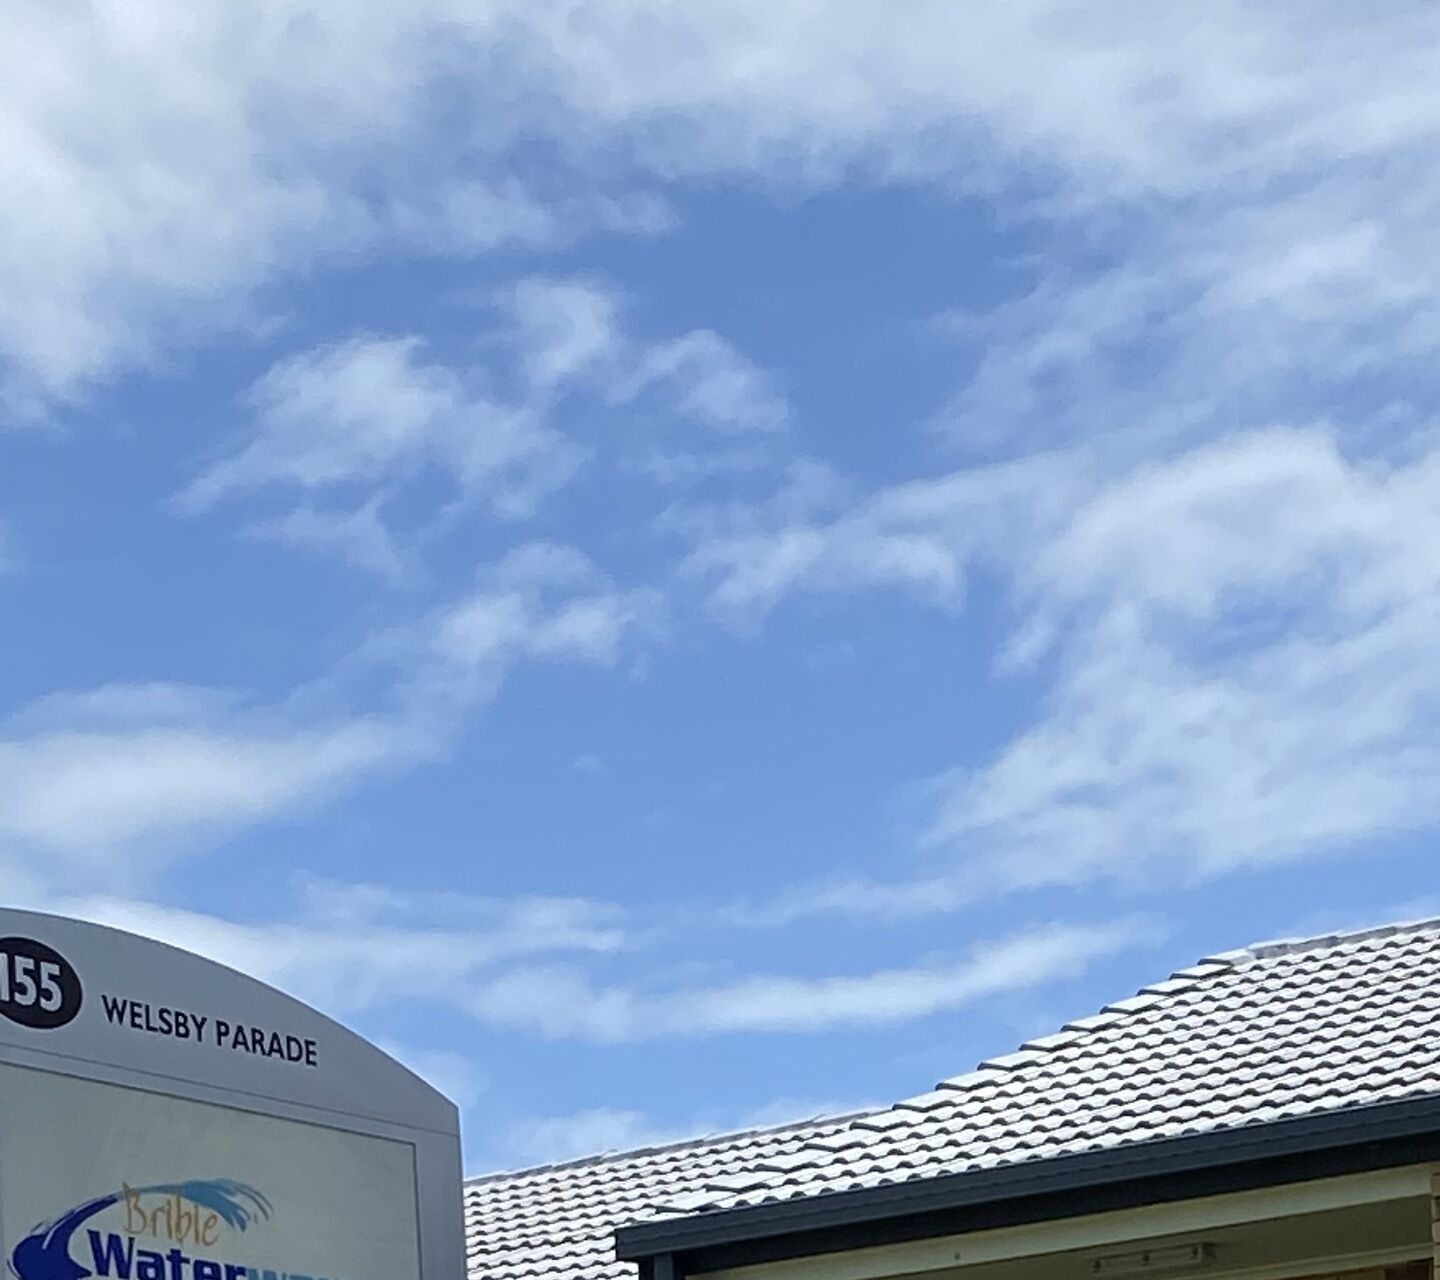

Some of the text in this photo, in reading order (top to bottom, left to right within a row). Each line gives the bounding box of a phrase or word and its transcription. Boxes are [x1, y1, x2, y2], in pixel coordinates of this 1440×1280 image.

[0, 952, 63, 1012] 155
[102, 994, 318, 1067] WELSBY PARADE
